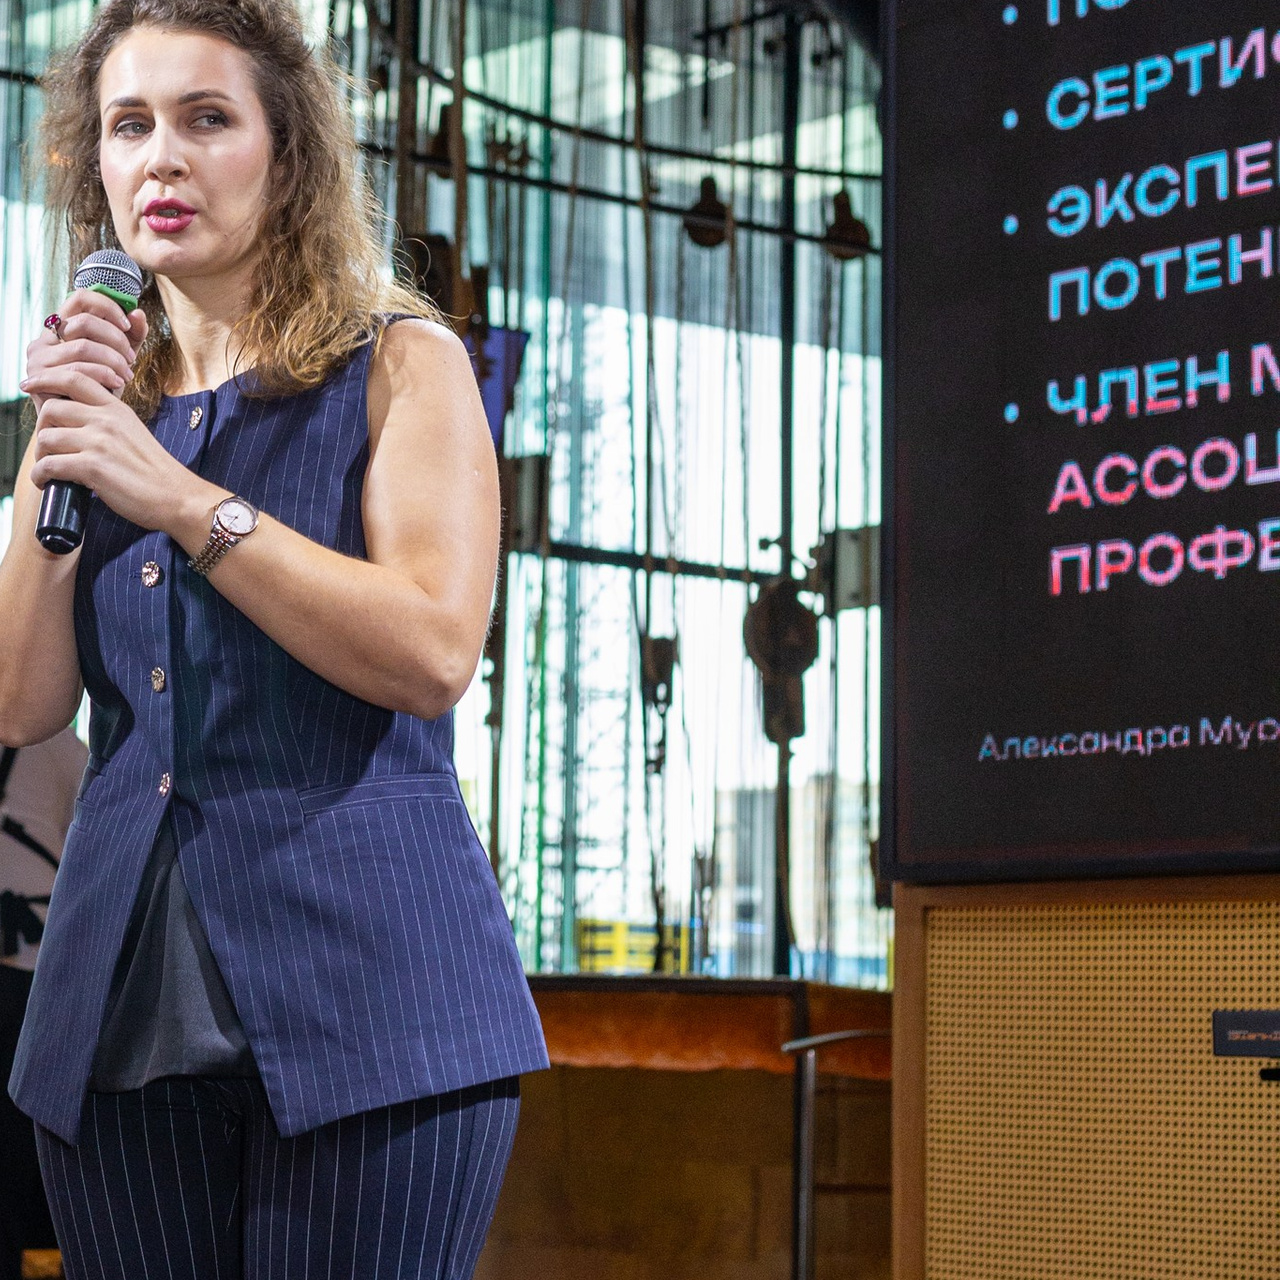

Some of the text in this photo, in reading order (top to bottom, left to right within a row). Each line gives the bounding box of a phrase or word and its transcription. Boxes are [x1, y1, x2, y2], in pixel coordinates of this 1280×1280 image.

[1046, 27, 1280, 130] СЕРТИ
[1047, 140, 1280, 237] ЭКСПЕ
[1048, 227, 1280, 321] ПОТЕН
[1046, 350, 1231, 425] ЧЛЕН
[1050, 517, 1280, 596] ПРОФЕ
[978, 723, 1190, 761] Александра
